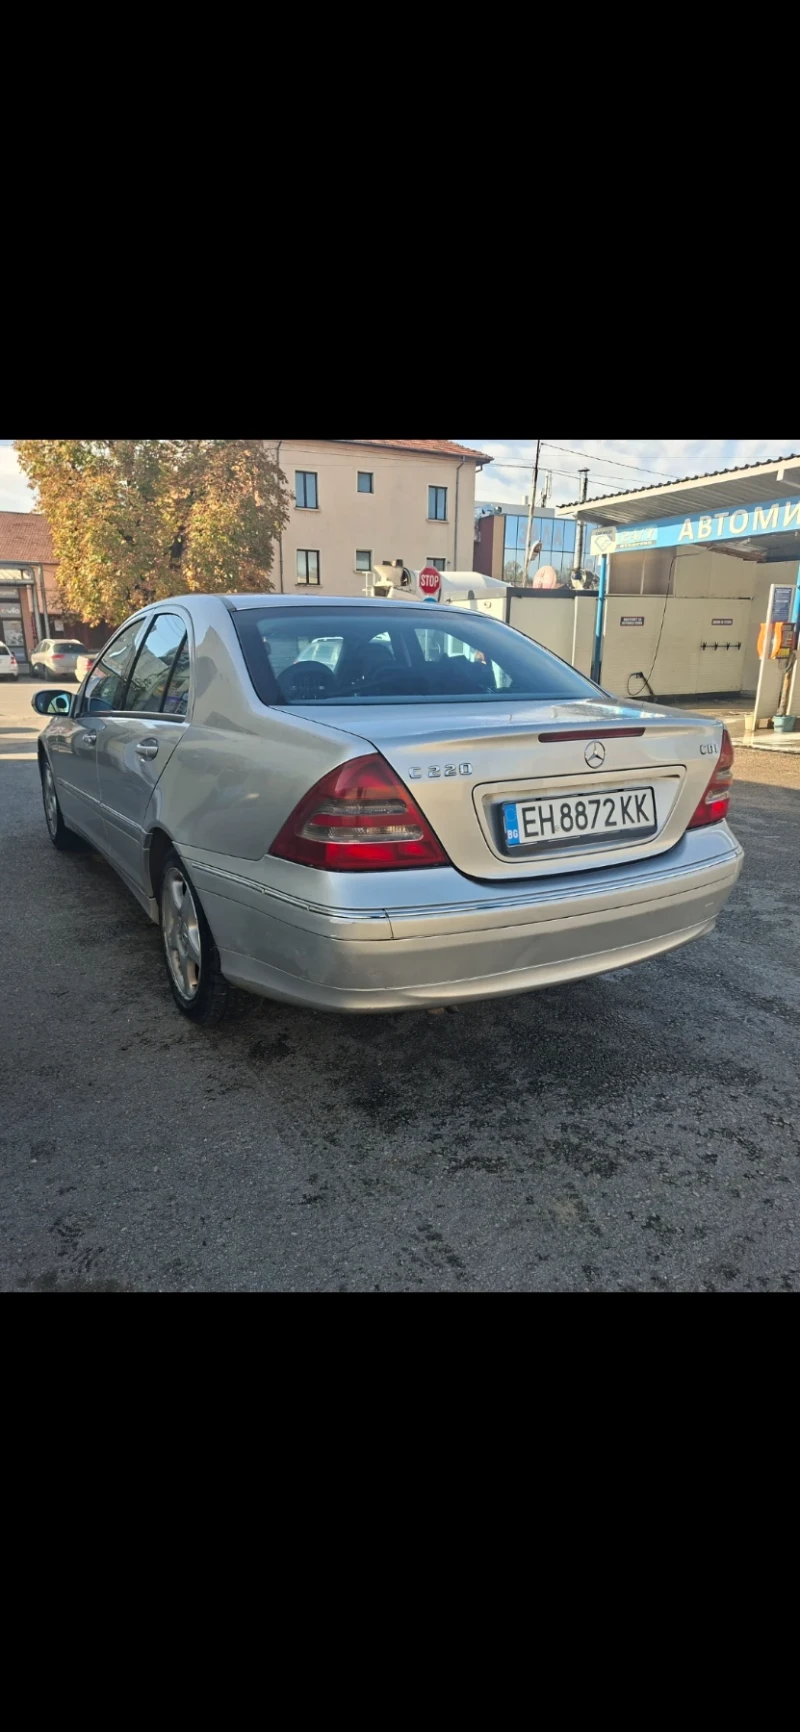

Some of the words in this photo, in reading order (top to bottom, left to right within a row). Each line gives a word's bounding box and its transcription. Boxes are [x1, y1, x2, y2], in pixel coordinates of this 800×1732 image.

[678, 501, 800, 541] АВТОМИ
[420, 574, 439, 587] STOP
[699, 743, 718, 755] CDI
[408, 766, 422, 779] C
[427, 762, 473, 778] 220
[507, 830, 519, 839] BG
